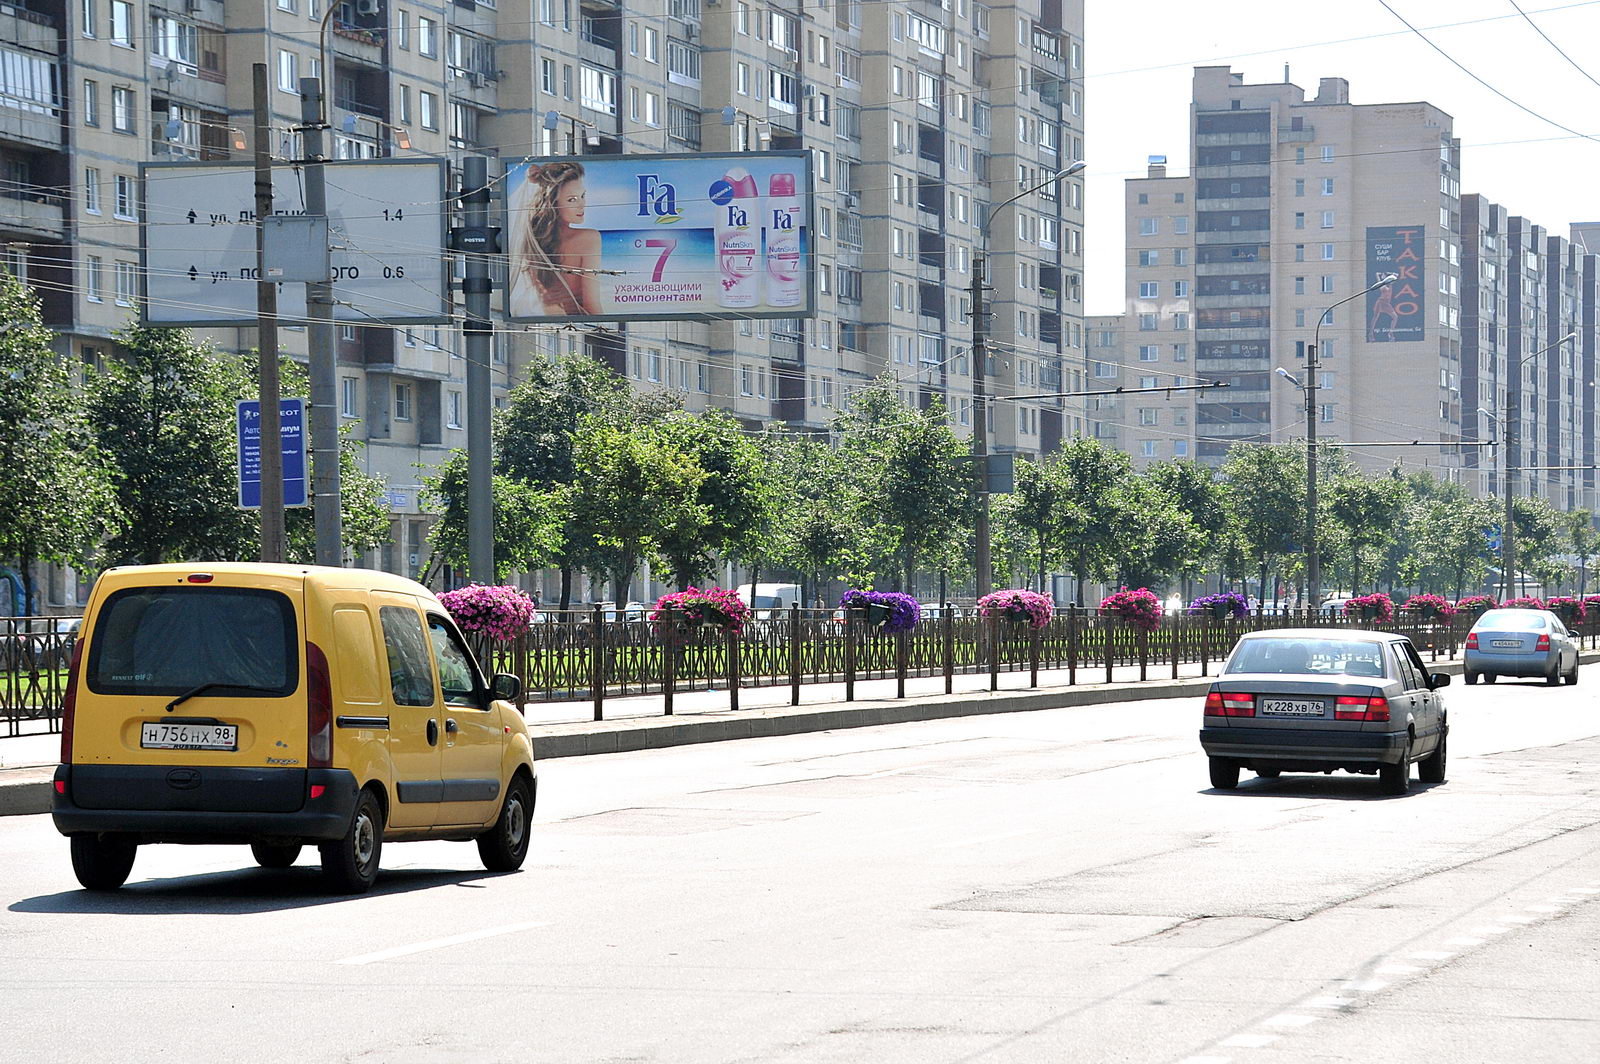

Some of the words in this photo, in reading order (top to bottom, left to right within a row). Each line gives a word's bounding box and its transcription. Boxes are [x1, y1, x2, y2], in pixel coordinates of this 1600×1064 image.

[637, 174, 677, 216] Fa
[210, 213, 231, 226] ул.
[383, 208, 403, 221] 1.4
[728, 206, 747, 226] Fa
[773, 209, 792, 230] Fa
[723, 240, 753, 248] NutriSkin
[645, 239, 677, 283] 7
[745, 256, 753, 266] 7
[211, 270, 231, 283] ул.
[383, 266, 404, 279] 0.6
[1394, 230, 1419, 316] ТАКАО
[614, 283, 702, 294] ухаживающими
[614, 293, 703, 303] компонентами
[1310, 702, 1321, 710] 76
[214, 727, 230, 740] 98
